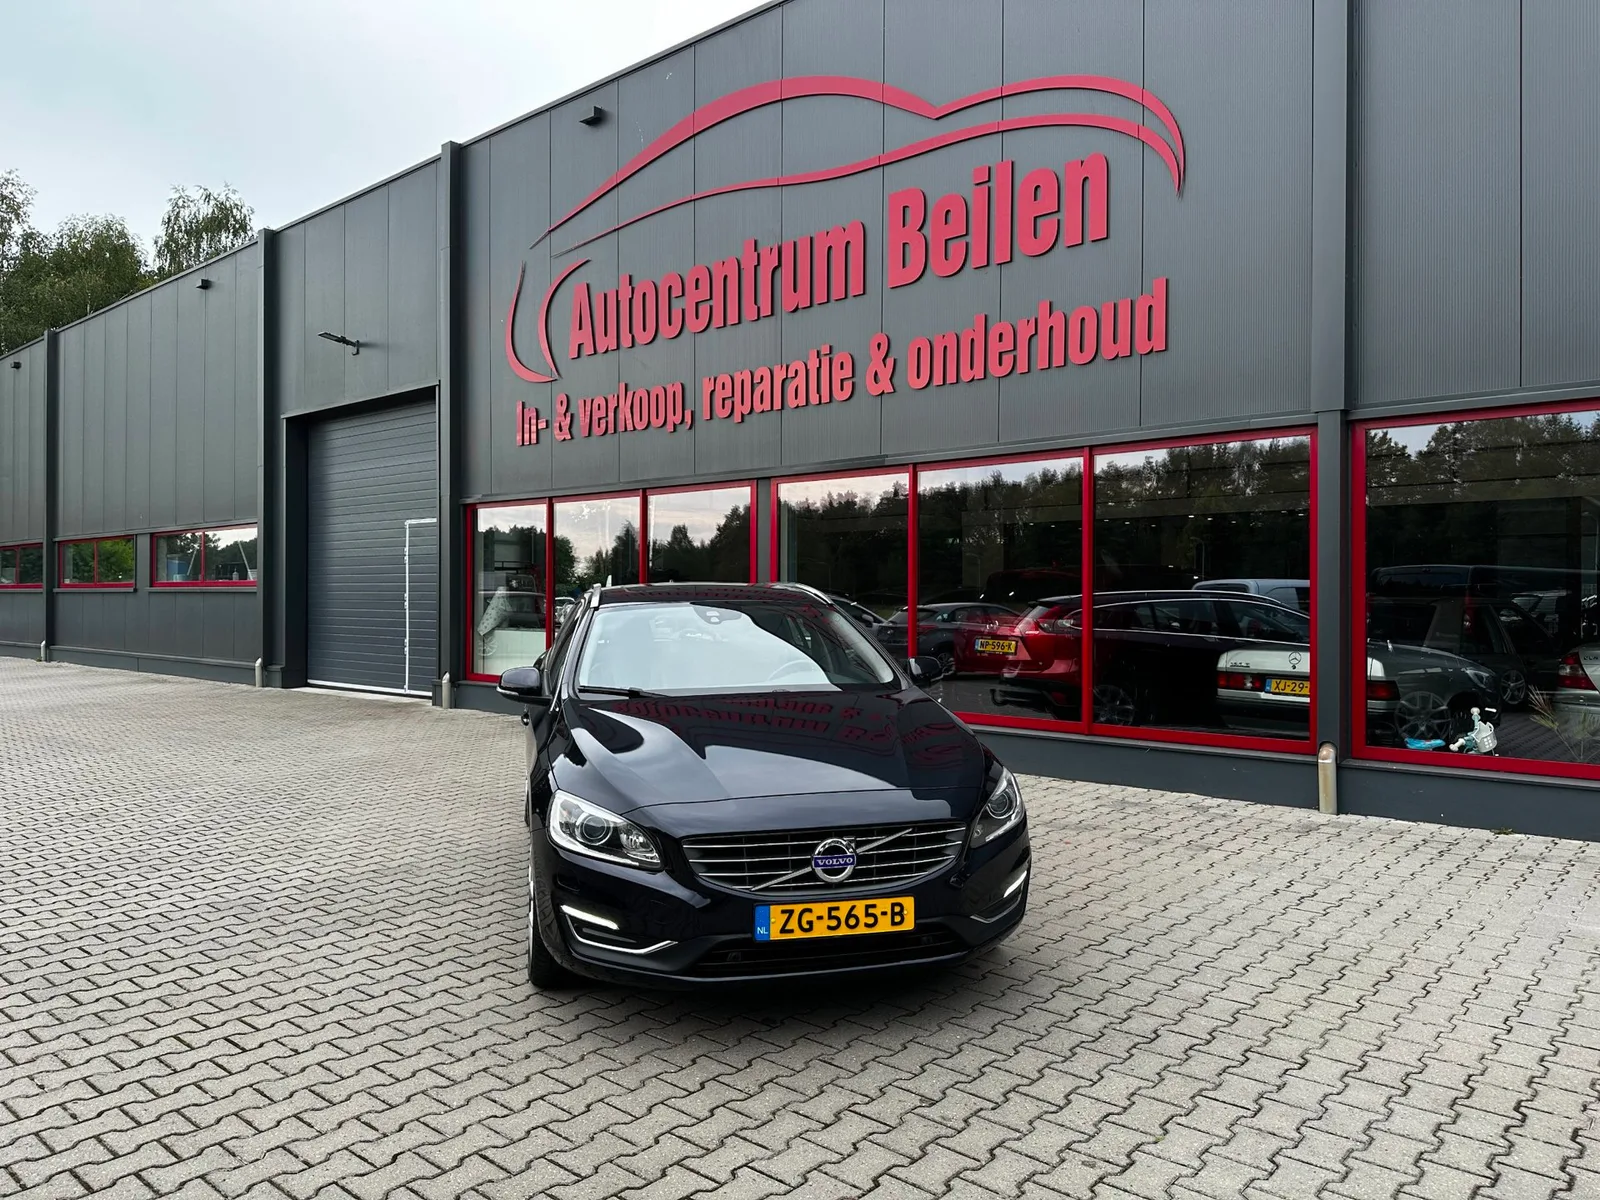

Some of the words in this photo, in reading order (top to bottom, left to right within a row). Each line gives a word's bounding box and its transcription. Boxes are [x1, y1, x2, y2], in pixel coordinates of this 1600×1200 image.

[569, 219, 865, 360] Autocentrum
[887, 152, 1109, 289] Beilen
[516, 400, 549, 446] In-
[554, 392, 572, 442] &
[578, 381, 694, 438] verkoop,
[702, 344, 855, 424] reparatie
[865, 332, 896, 397] &
[907, 276, 1168, 390] onderhoud
[1273, 680, 1309, 693] XJ-29-
[816, 856, 854, 866] VOLVO
[757, 926, 769, 935] NL
[779, 901, 906, 935] ZG-565-B
